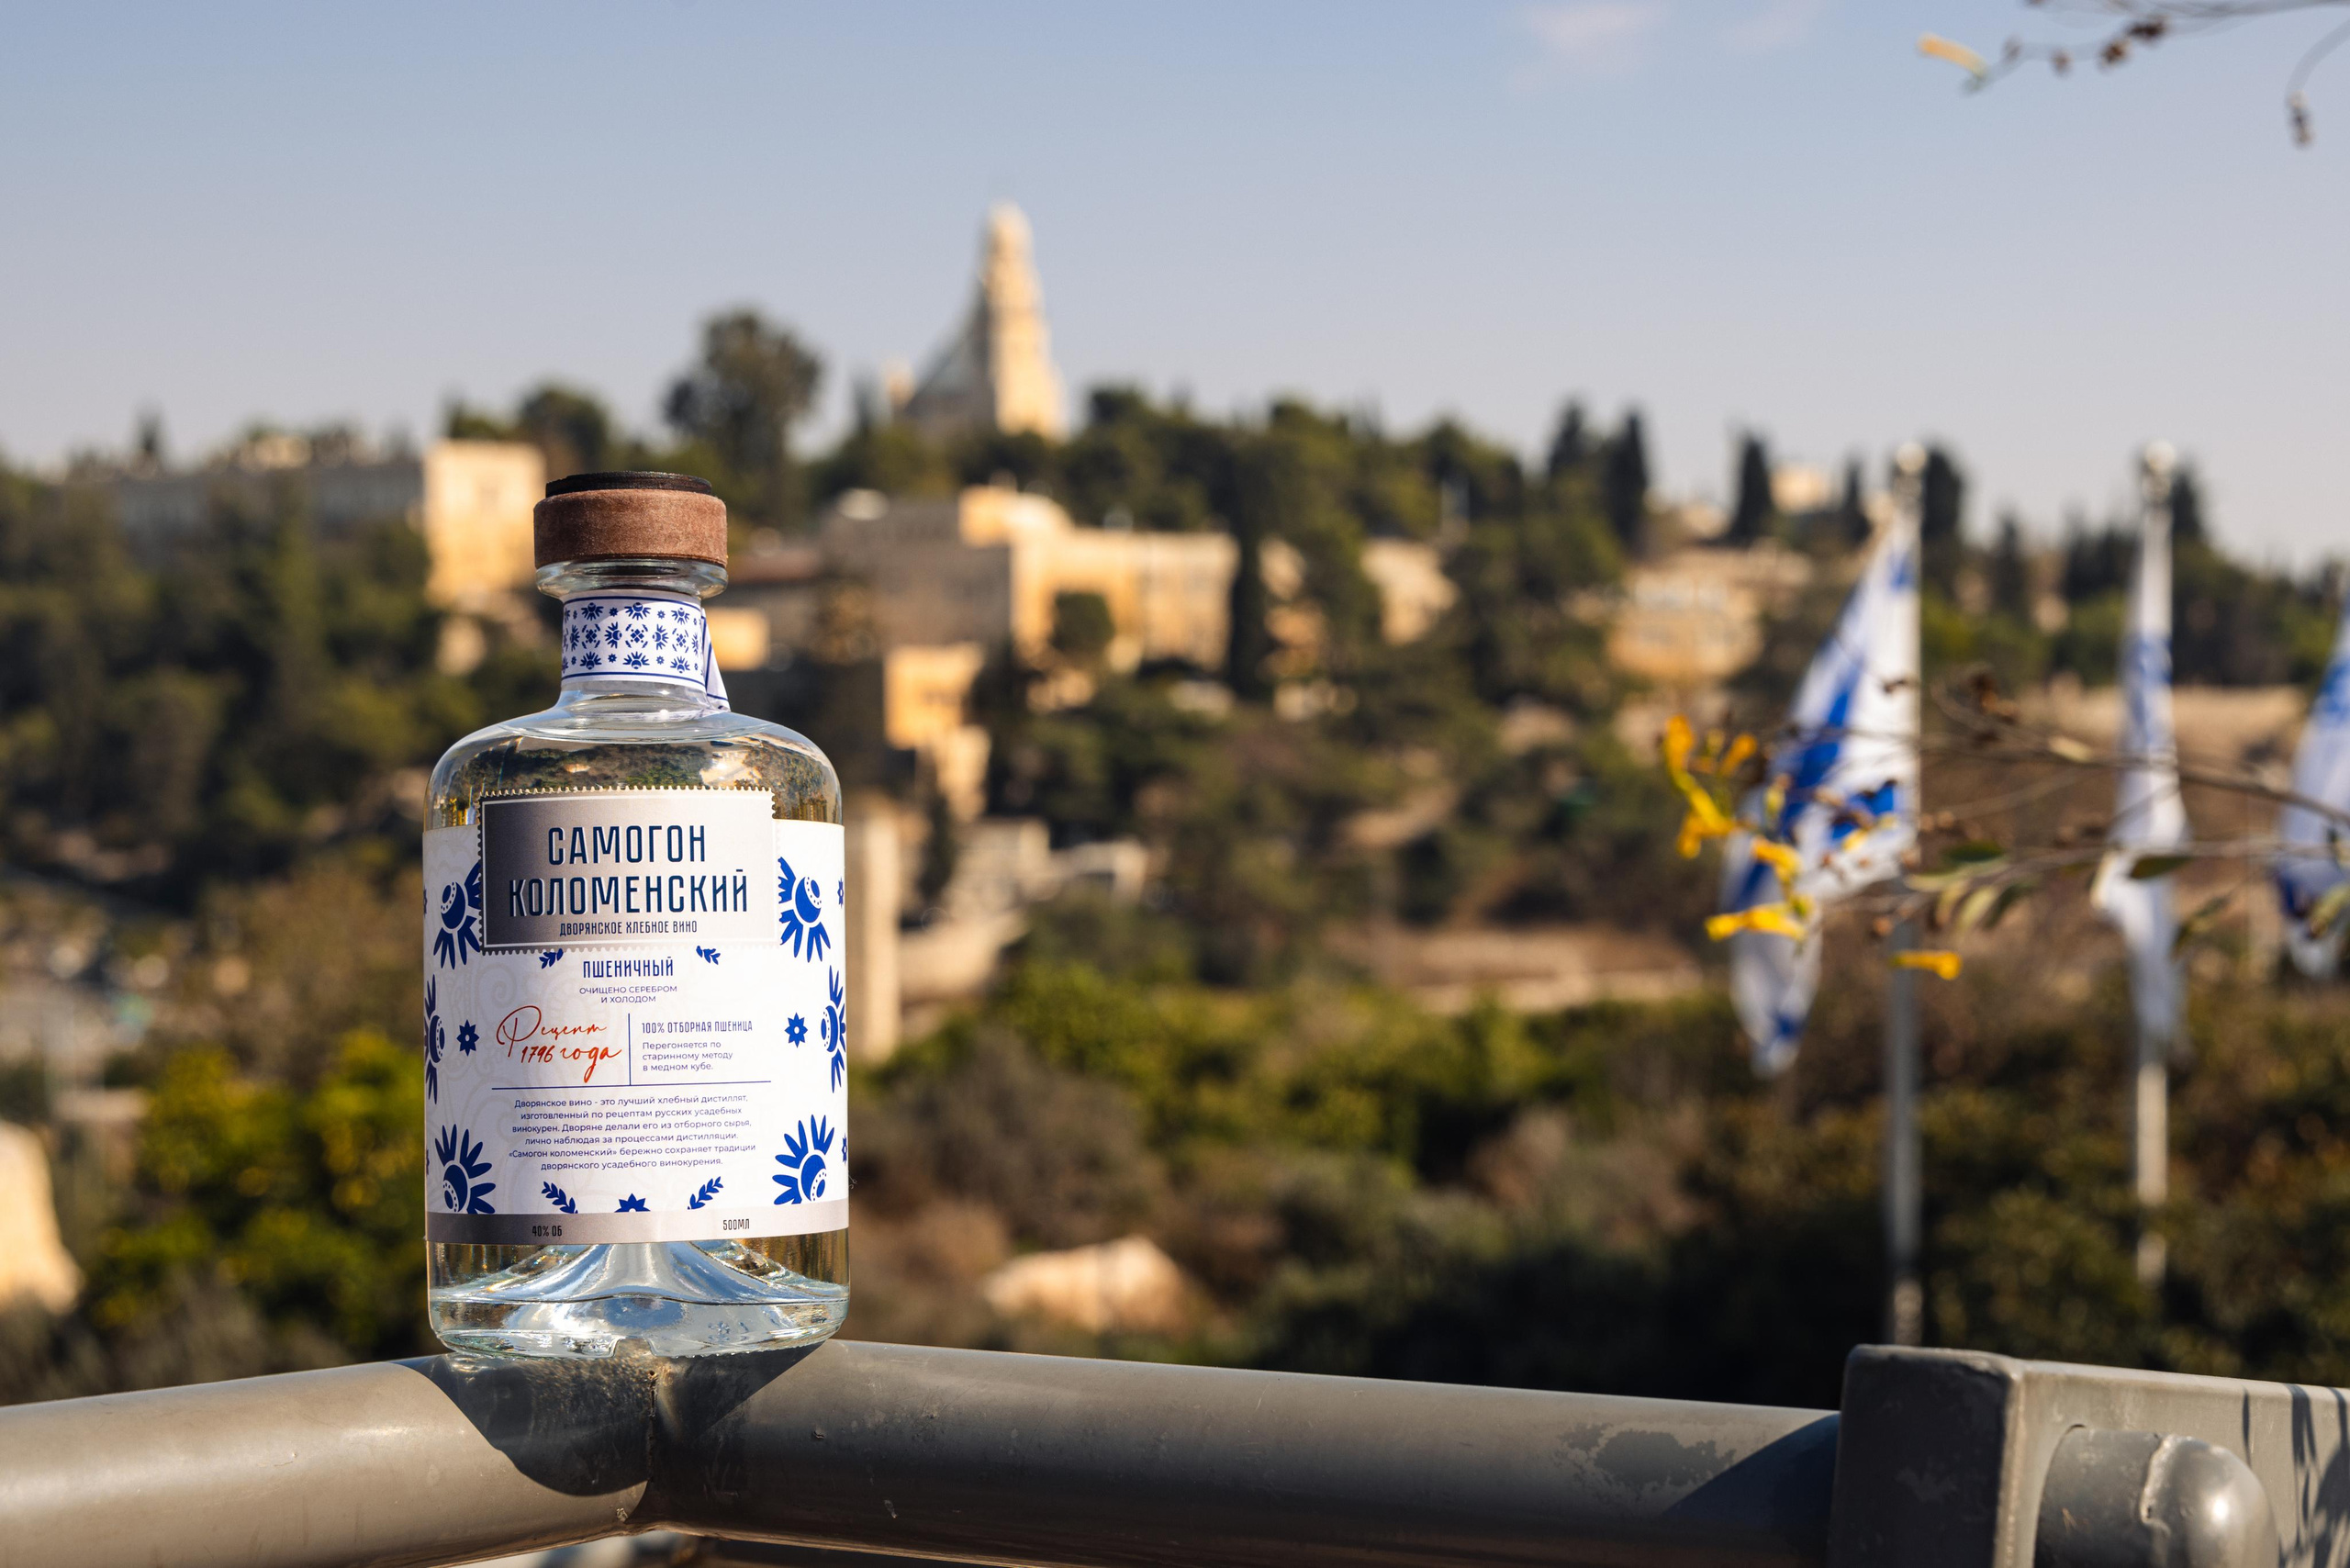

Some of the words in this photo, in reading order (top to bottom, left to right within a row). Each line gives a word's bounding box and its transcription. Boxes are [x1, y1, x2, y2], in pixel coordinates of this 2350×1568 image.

[548, 824, 706, 866] САМОГОН
[509, 868, 747, 917] КОЛОМЕНСКИЙ
[559, 921, 622, 937] ДВОРЯНСКОЕ
[626, 920, 669, 934] ХЛЕБНОЕ
[673, 920, 698, 934] ВИНО
[582, 956, 674, 979] ПШЕНИЧНЫЙ
[579, 986, 627, 995] ОЧИЩЕНО
[628, 985, 677, 993] СЕРЕБРОМ
[609, 995, 656, 1003] ХОЛОДОМ
[496, 1005, 607, 1058] Рецепт
[642, 1022, 666, 1034] 100%
[667, 1021, 711, 1033] ОТБОРНАЯ
[714, 1020, 754, 1032] ПШЕНИЦА
[642, 1041, 709, 1051] Перегоняется
[642, 1051, 700, 1062] старинному
[701, 1050, 733, 1060] методу
[520, 1046, 555, 1063] 1796
[559, 1047, 622, 1083] года
[650, 1062, 688, 1072] медном
[689, 1061, 714, 1072] кубе.
[514, 1099, 567, 1109] Дворянское
[618, 1097, 655, 1106] лучший
[657, 1095, 699, 1103] хлебный
[700, 1095, 748, 1103] дистиллят,
[520, 1111, 589, 1120] изготовленный
[605, 1110, 653, 1119] рецептам
[655, 1109, 692, 1118] русских
[694, 1107, 742, 1116] усадебных
[512, 1126, 560, 1134] винокурен.
[562, 1124, 603, 1133] Дворяне
[605, 1123, 641, 1131] делали
[674, 1120, 722, 1129] отборного
[724, 1120, 752, 1128] сырья,
[554, 1137, 599, 1145] наблюдая
[615, 1135, 674, 1144] процессами
[676, 1132, 738, 1142] дистилляции.
[509, 1149, 548, 1158] «Самогон
[550, 1148, 617, 1158] коломенский»
[620, 1147, 663, 1156] бережно
[665, 1145, 711, 1155] сохраняет
[714, 1144, 755, 1153] традиции
[541, 1161, 599, 1171] дворянского
[601, 1159, 657, 1170] усадебного
[659, 1158, 723, 1168] винокурения.
[722, 1218, 750, 1231] 500МЛ
[532, 1225, 549, 1238] 40%
[552, 1225, 563, 1237] ОБ
